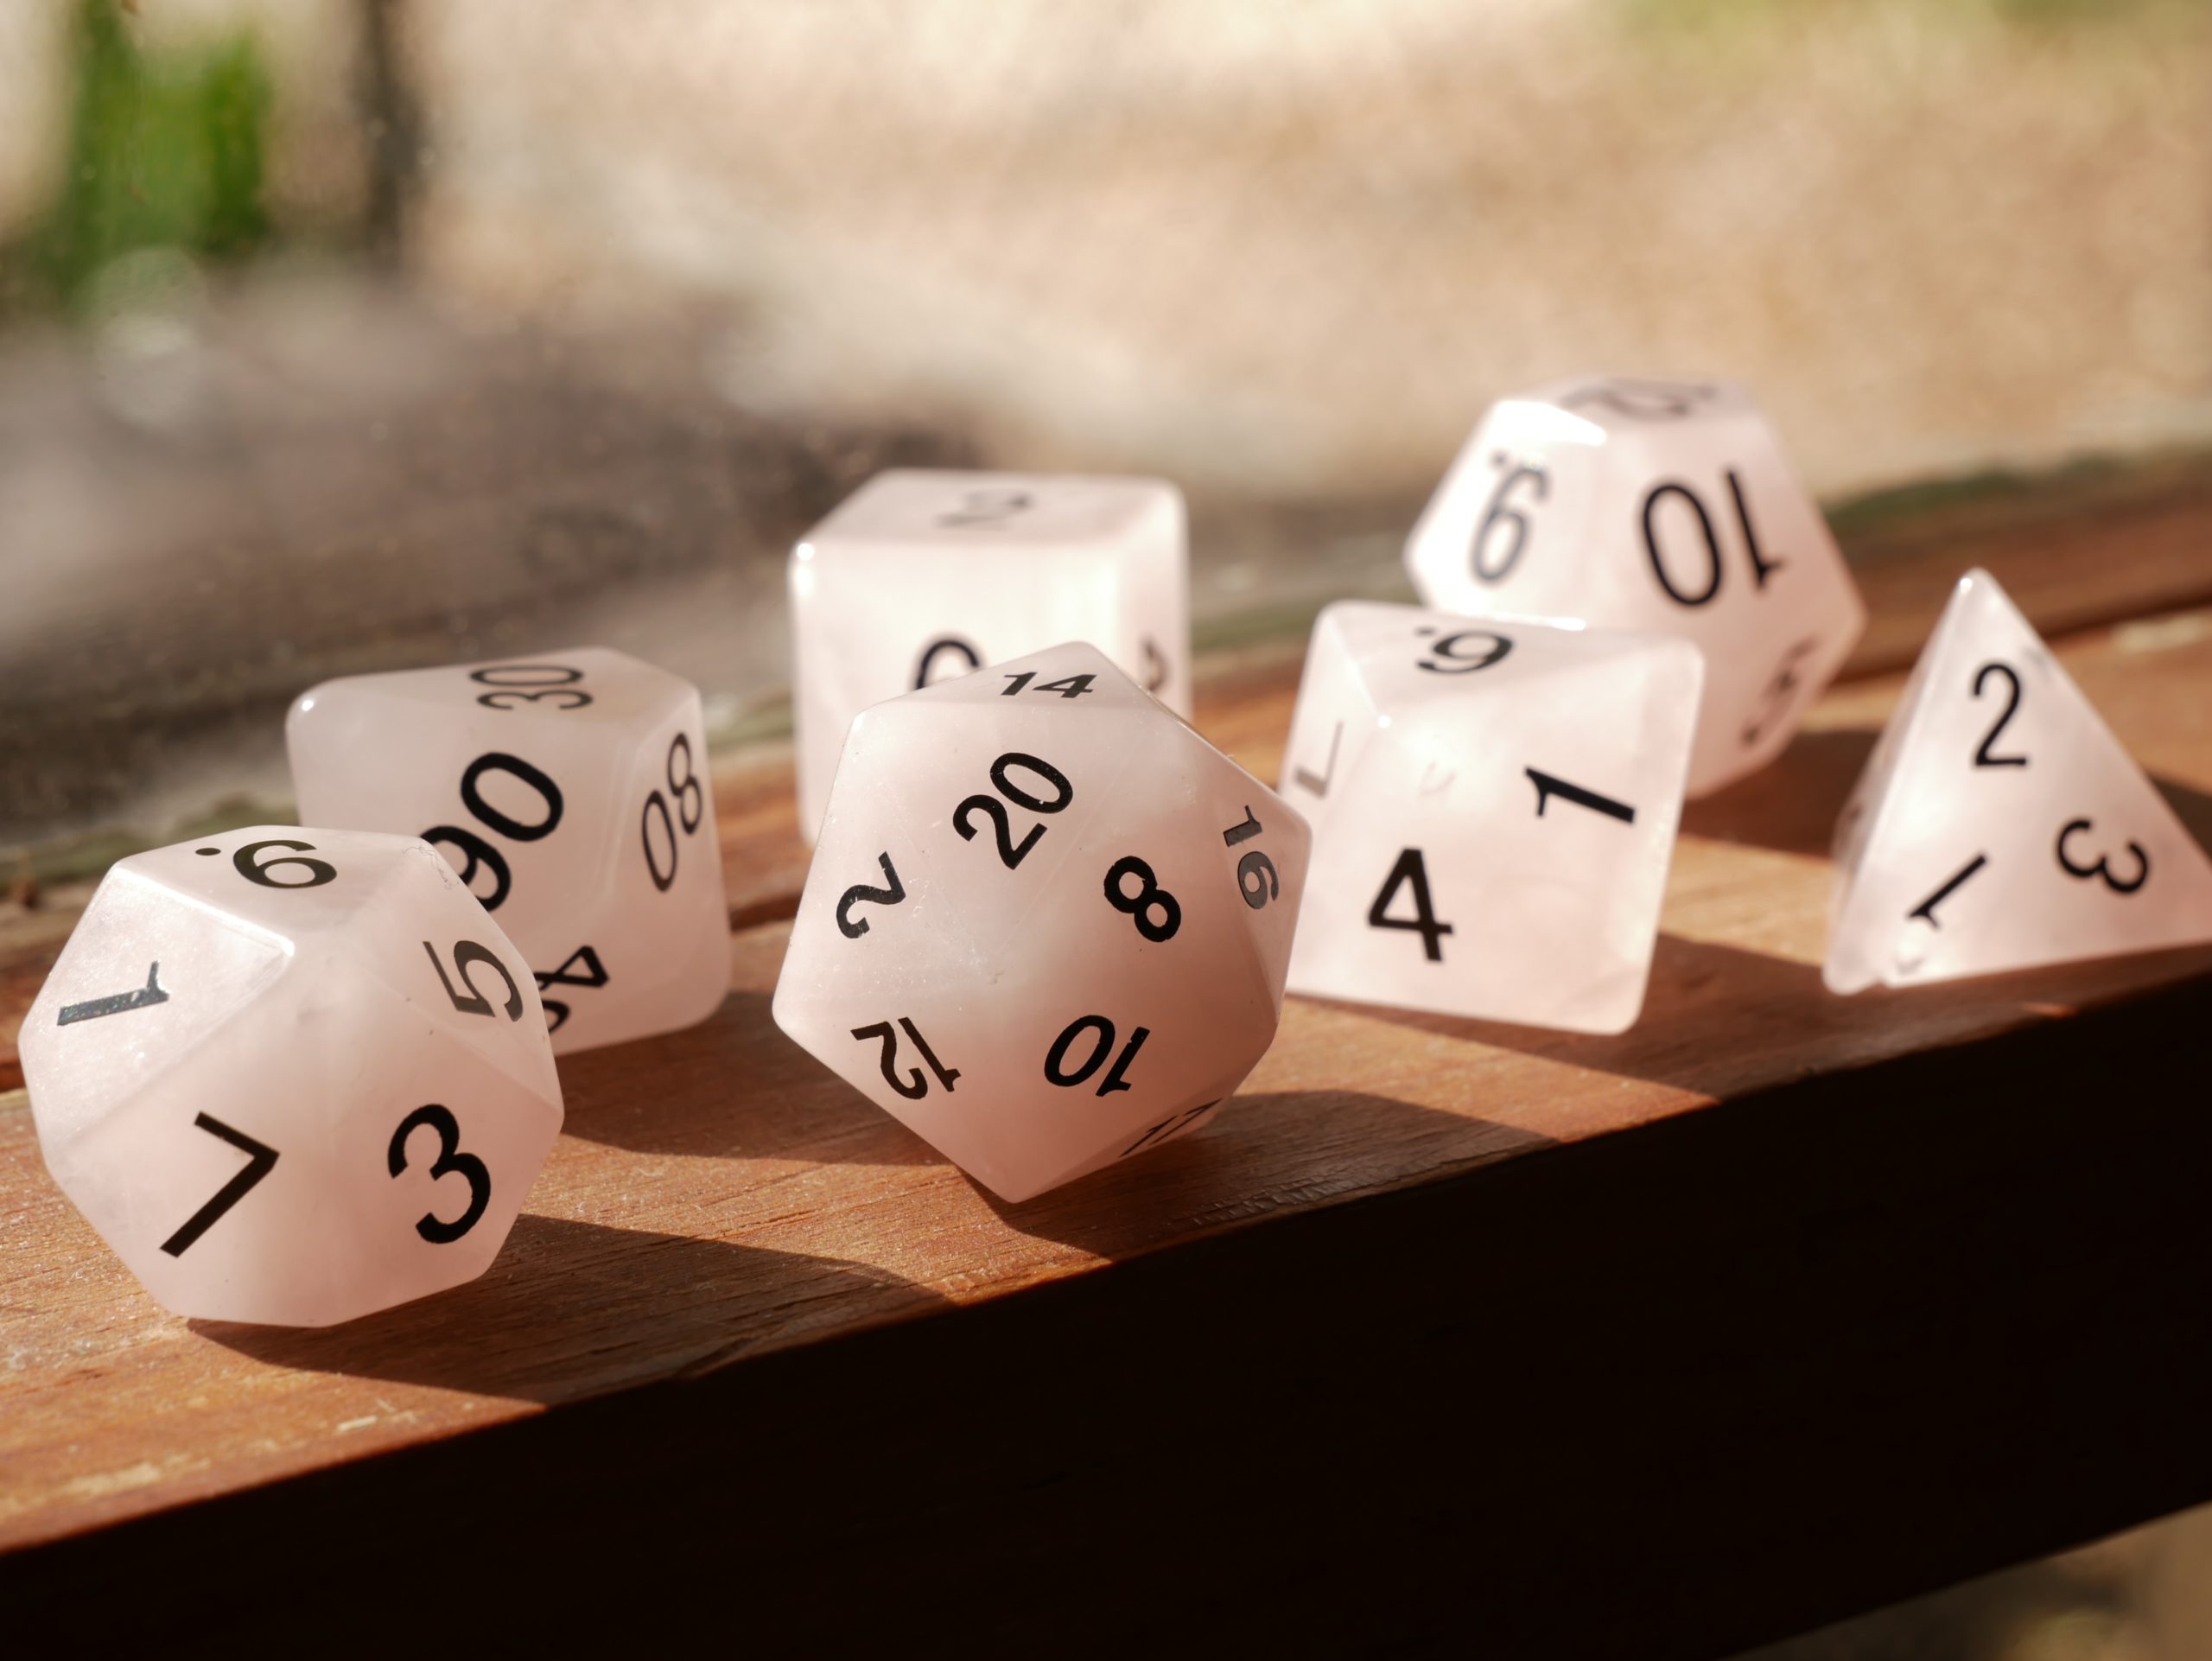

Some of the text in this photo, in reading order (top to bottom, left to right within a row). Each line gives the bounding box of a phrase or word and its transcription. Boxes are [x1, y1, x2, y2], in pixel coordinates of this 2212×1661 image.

[1641, 464, 1789, 608] 10
[469, 665, 593, 710] 30
[1001, 671, 1097, 698] 14
[1974, 663, 2029, 766] 2
[642, 732, 702, 892] 80
[952, 752, 1073, 870] 20
[1524, 765, 1636, 824] 1
[836, 851, 906, 939] 2
[1103, 856, 1182, 943] 8
[1223, 805, 1280, 910] 16
[1907, 853, 1987, 930] 1
[2058, 818, 2150, 894] 3
[1367, 848, 1454, 964] 4
[57, 960, 169, 1027] 1
[423, 939, 524, 1022] 5
[850, 1016, 962, 1100] 12
[1044, 1015, 1151, 1098] 10
[160, 1111, 280, 1259] 7
[387, 1104, 492, 1244] 3
